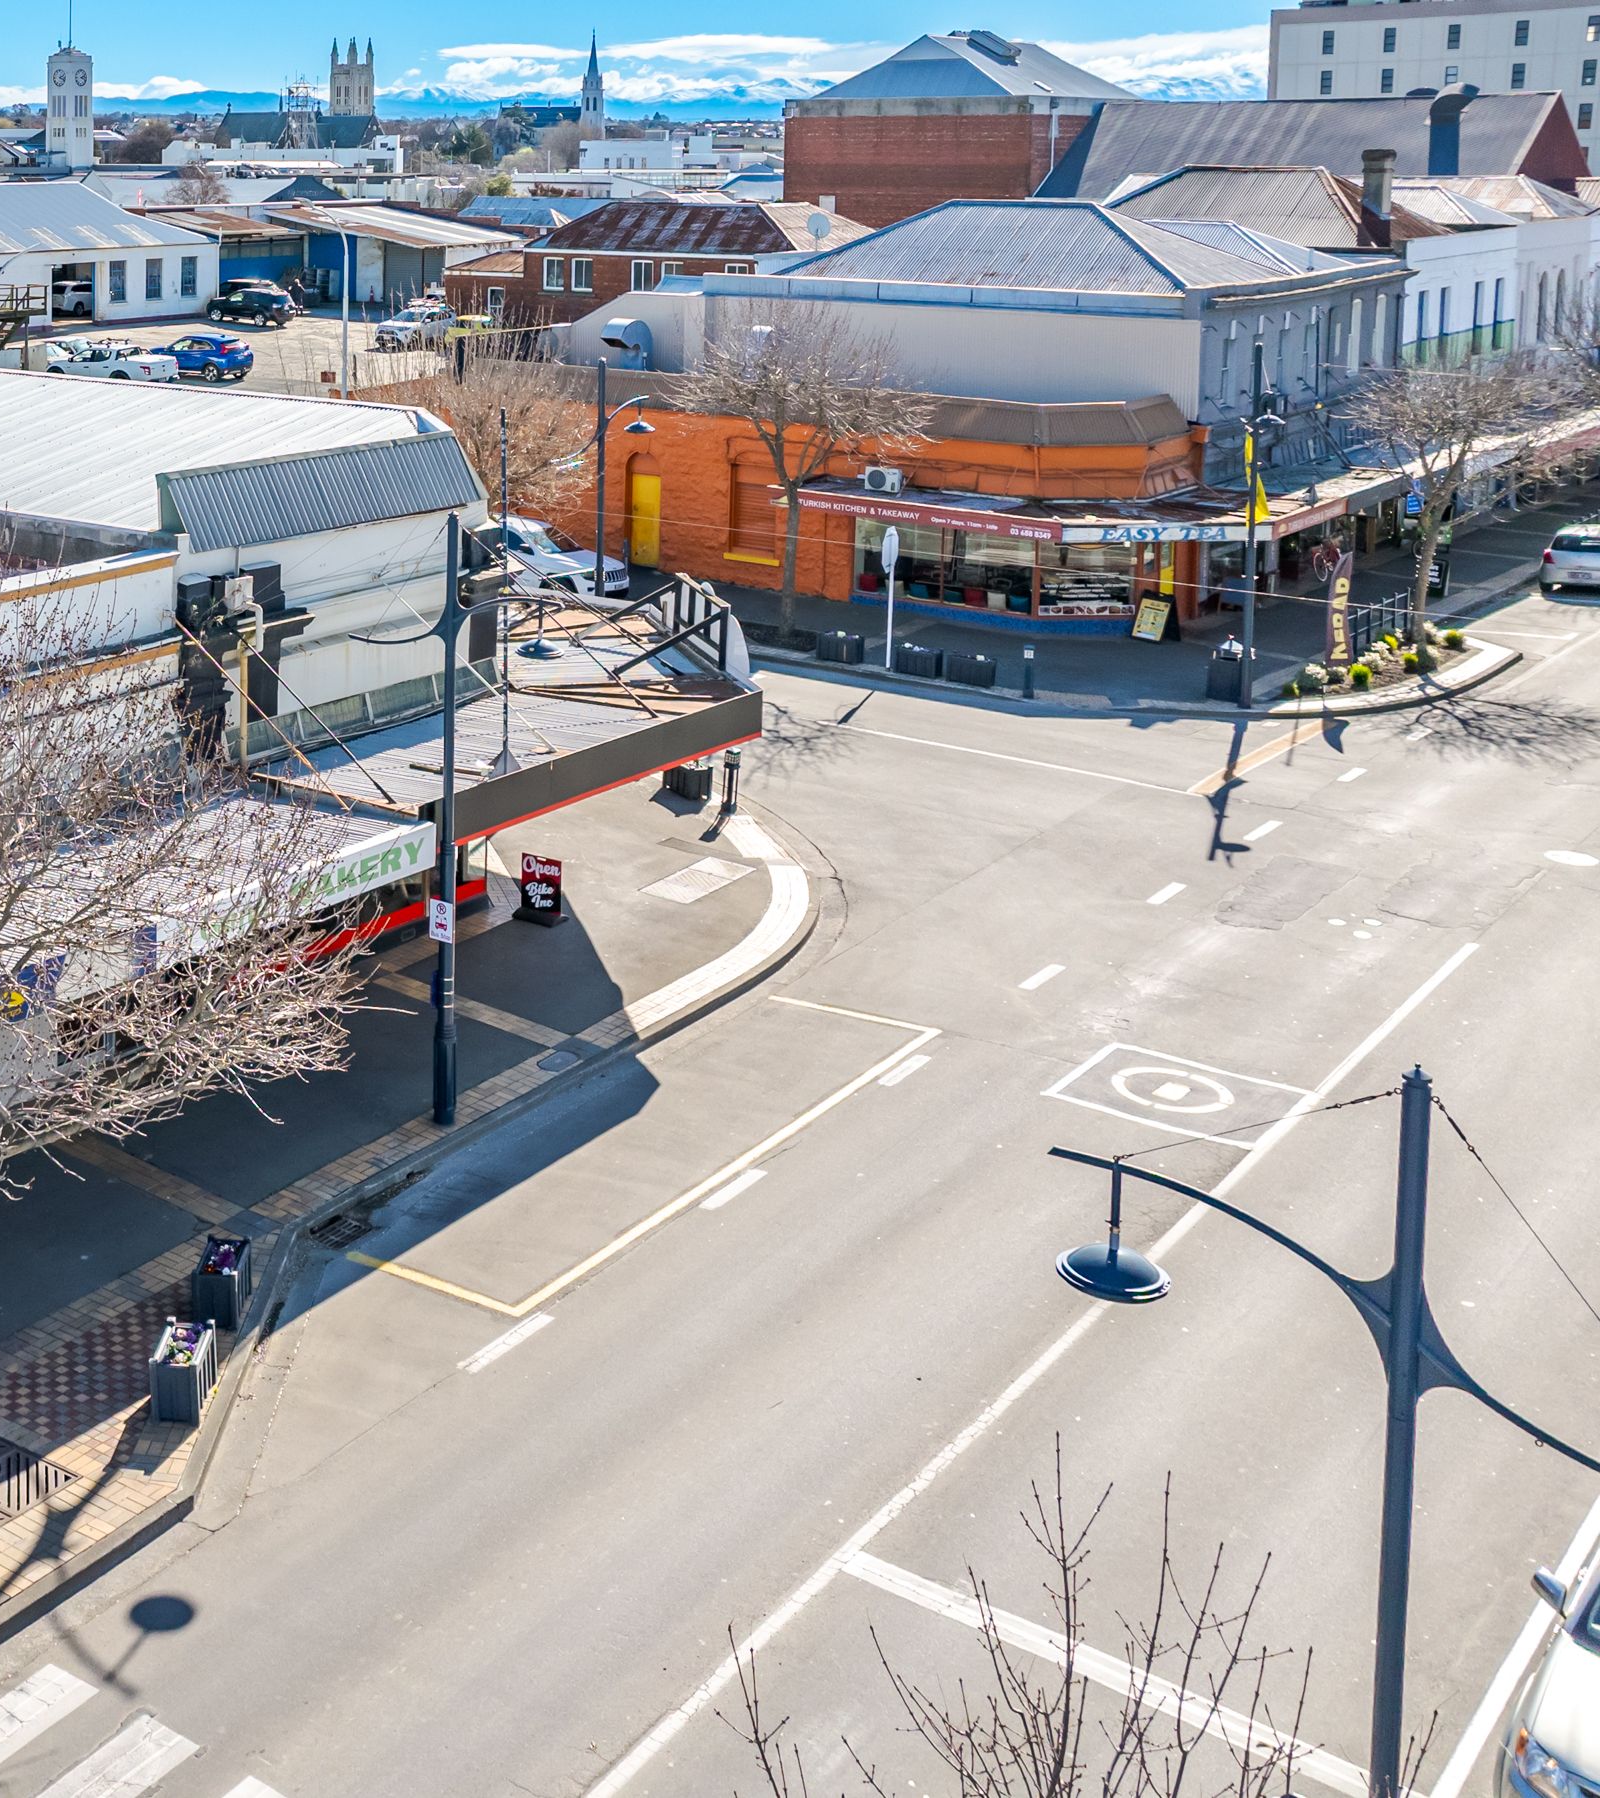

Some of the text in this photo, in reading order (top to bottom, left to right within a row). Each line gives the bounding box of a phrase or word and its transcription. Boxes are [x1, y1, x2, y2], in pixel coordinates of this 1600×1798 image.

[798, 498, 920, 520] TURKISH KITCHEN & TAKEAWAY
[1010, 528, 1020, 536] 03
[1101, 526, 1227, 541] EASY TEA
[523, 855, 561, 879] Open
[525, 881, 554, 896] Bike
[531, 894, 554, 908] Inc
